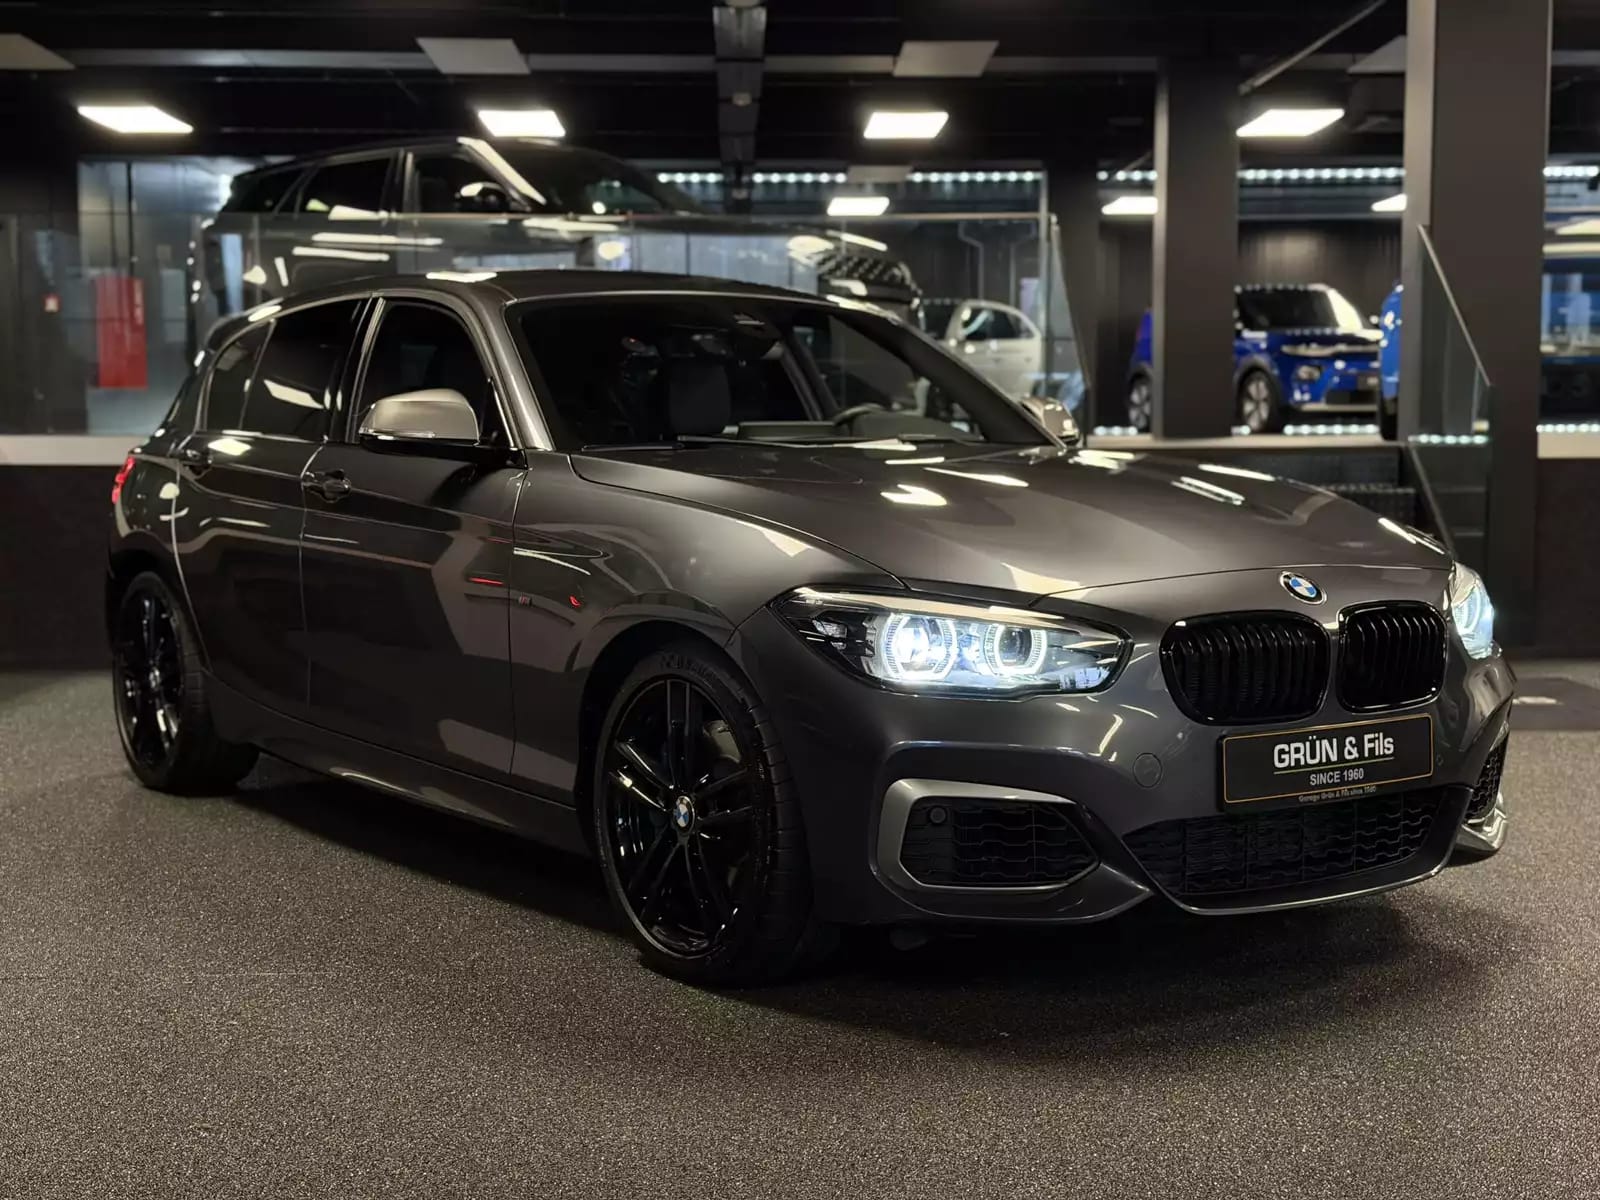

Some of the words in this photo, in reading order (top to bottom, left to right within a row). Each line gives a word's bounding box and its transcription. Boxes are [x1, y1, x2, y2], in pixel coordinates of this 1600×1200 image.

[1273, 735, 1338, 768] GRÜN
[1344, 736, 1359, 760] &
[1363, 732, 1394, 757] Fils
[1309, 771, 1341, 786] SINCE
[1342, 768, 1364, 781] 1960
